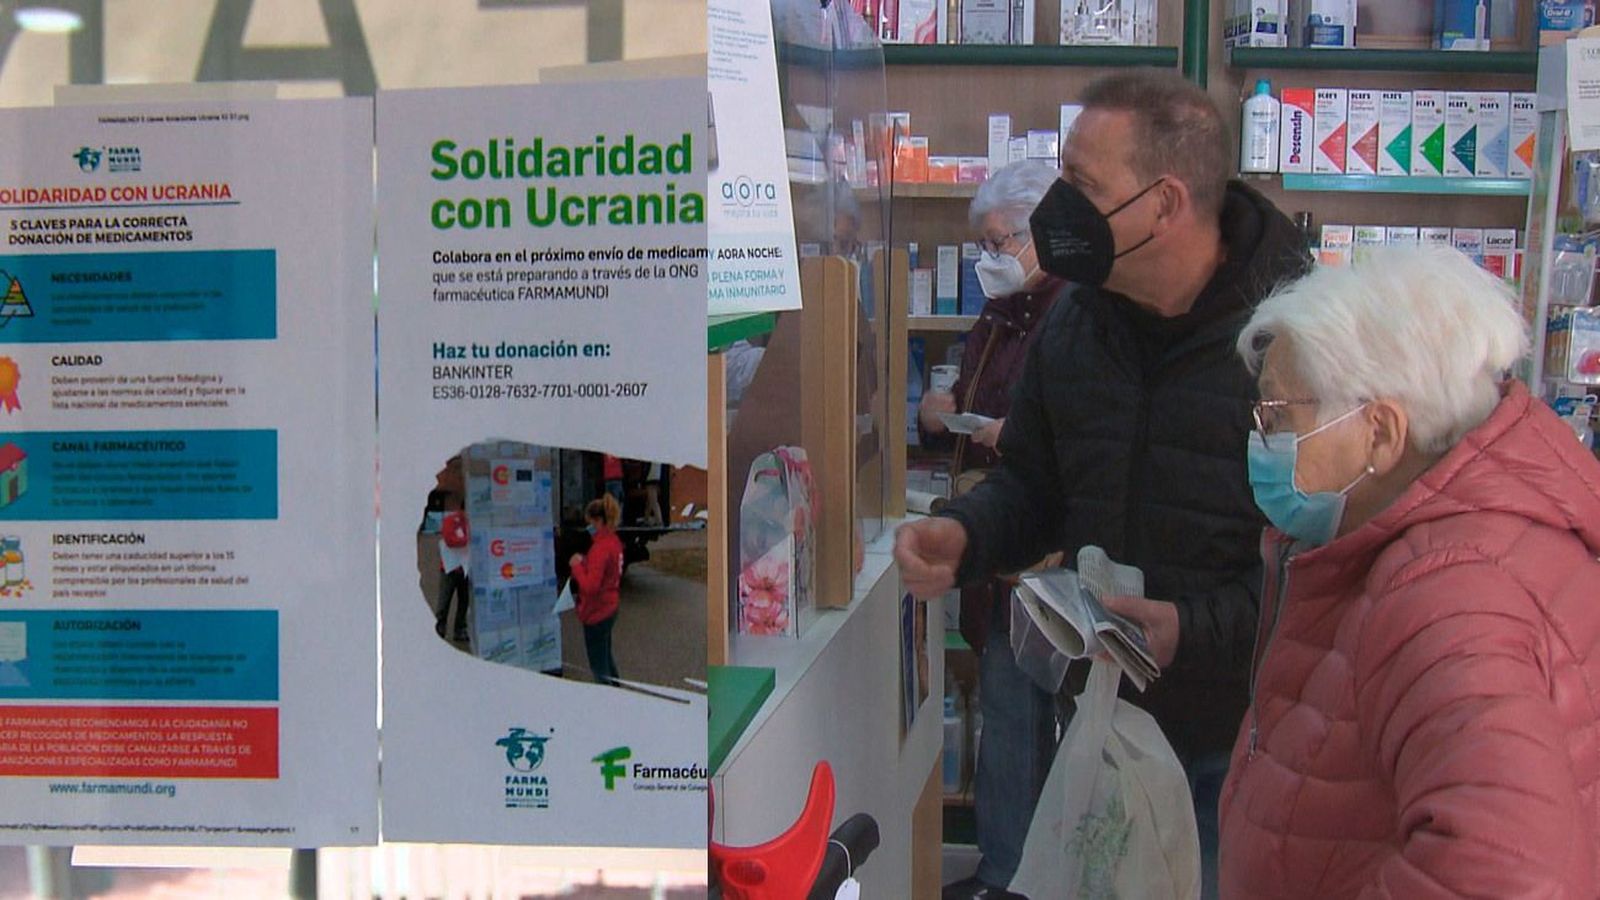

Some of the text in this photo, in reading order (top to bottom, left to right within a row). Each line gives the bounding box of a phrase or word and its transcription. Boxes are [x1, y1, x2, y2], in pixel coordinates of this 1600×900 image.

[1290, 110, 1302, 164] Desensin
[430, 133, 692, 181] Solidaridad
[110, 186, 148, 200] CON
[152, 184, 232, 200] UCRANIA
[722, 182, 776, 200] aora
[430, 182, 704, 230] con Ucrania
[10, 217, 188, 230] 5 CLAVES PARA LA CORRECTA
[8, 231, 193, 246] DONACIÓN DE MEDICAMENTOS
[1487, 236, 1514, 245] Lacer
[432, 244, 708, 265] Colabora en el próximo envío de medicam
[718, 248, 746, 260] AORA
[748, 247, 783, 258] NOCHE:
[52, 272, 132, 283] NECESIDADES
[432, 264, 699, 286] que se está preparando a través de la ONG
[712, 268, 784, 282] PLENA FORMA Y
[432, 284, 610, 302] farmacéutica FARMAMUNDI
[726, 285, 786, 298] INMUNITARIO
[432, 340, 612, 360] Haz tu donación en:
[52, 356, 103, 366] CALIDAD
[432, 364, 513, 380] BANKINTER
[52, 376, 80, 385] Deben
[117, 376, 128, 384] de
[130, 376, 146, 384] una
[148, 374, 174, 384] fuente
[177, 374, 216, 384] fidedigna
[98, 388, 110, 396] las
[144, 388, 155, 396] de
[156, 387, 188, 396] calidad
[196, 386, 223, 396] figurar
[432, 383, 648, 400] ES36-0128-7632-7701-0001-2607
[108, 400, 119, 408] de
[120, 399, 183, 408] medicamentos
[52, 440, 186, 452] CANAL FARMACÉUTICO
[52, 533, 146, 545] IDENTIFICACIÓN
[53, 552, 80, 560] Deben
[82, 552, 103, 560] tener
[123, 552, 168, 560] caducidad
[169, 552, 204, 561] superior
[213, 552, 225, 560] los
[186, 564, 216, 572] idioma
[112, 578, 126, 586] por
[141, 576, 196, 586] profesionales
[198, 576, 209, 584] de
[211, 576, 234, 584] salud
[236, 576, 249, 584] del
[53, 620, 142, 632] AUTORIZACIÓN
[6, 718, 68, 728] FARMAMUNDI
[70, 718, 149, 728] RECOMENDAMOS
[160, 719, 171, 728] LA
[233, 719, 248, 728] NO
[74, 732, 87, 740] DE
[166, 732, 178, 740] LA
[20, 744, 32, 752] DE
[34, 744, 45, 752] LA
[239, 744, 252, 754] DE
[142, 757, 170, 766] COMO
[172, 757, 237, 768] FARMAMUNDI
[633, 763, 708, 779] Farmacéu
[506, 776, 548, 786] FARMA
[50, 782, 176, 798] www.farmamundi.org
[506, 787, 549, 798] MUNDI
